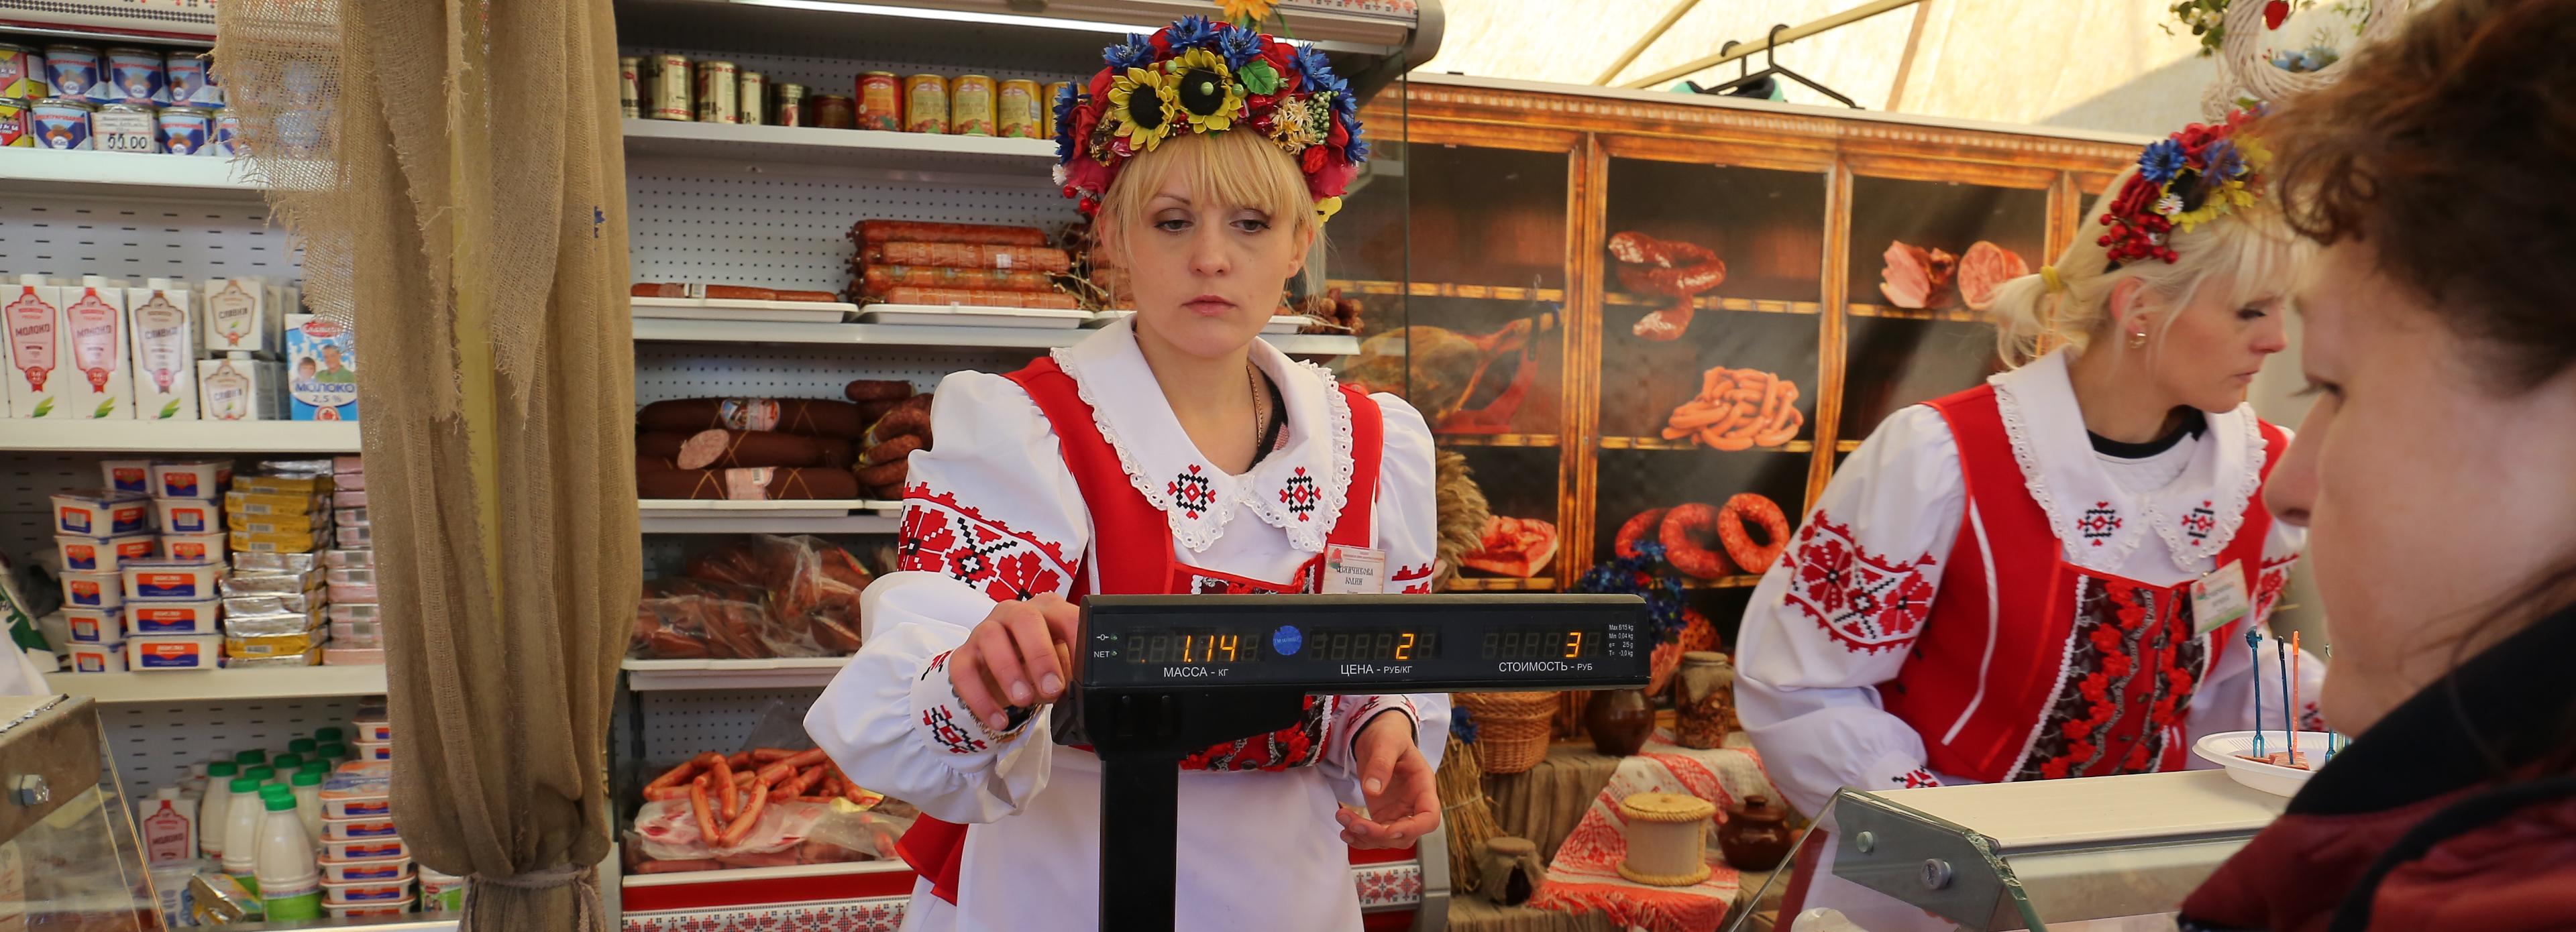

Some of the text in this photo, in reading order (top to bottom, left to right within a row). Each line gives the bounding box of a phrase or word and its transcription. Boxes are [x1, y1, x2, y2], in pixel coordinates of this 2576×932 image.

[15, 323, 50, 337] МОЛОКО
[296, 384, 356, 393] МОЛОКО
[1396, 632, 1415, 660] 2
[1565, 632, 1582, 658] 3
[1164, 666, 1208, 677] МАССА
[1341, 664, 1374, 677] ЦЕНА
[1383, 666, 1413, 674] РУБ/КГ
[1499, 662, 1568, 672] СТОИМОСТЬ
